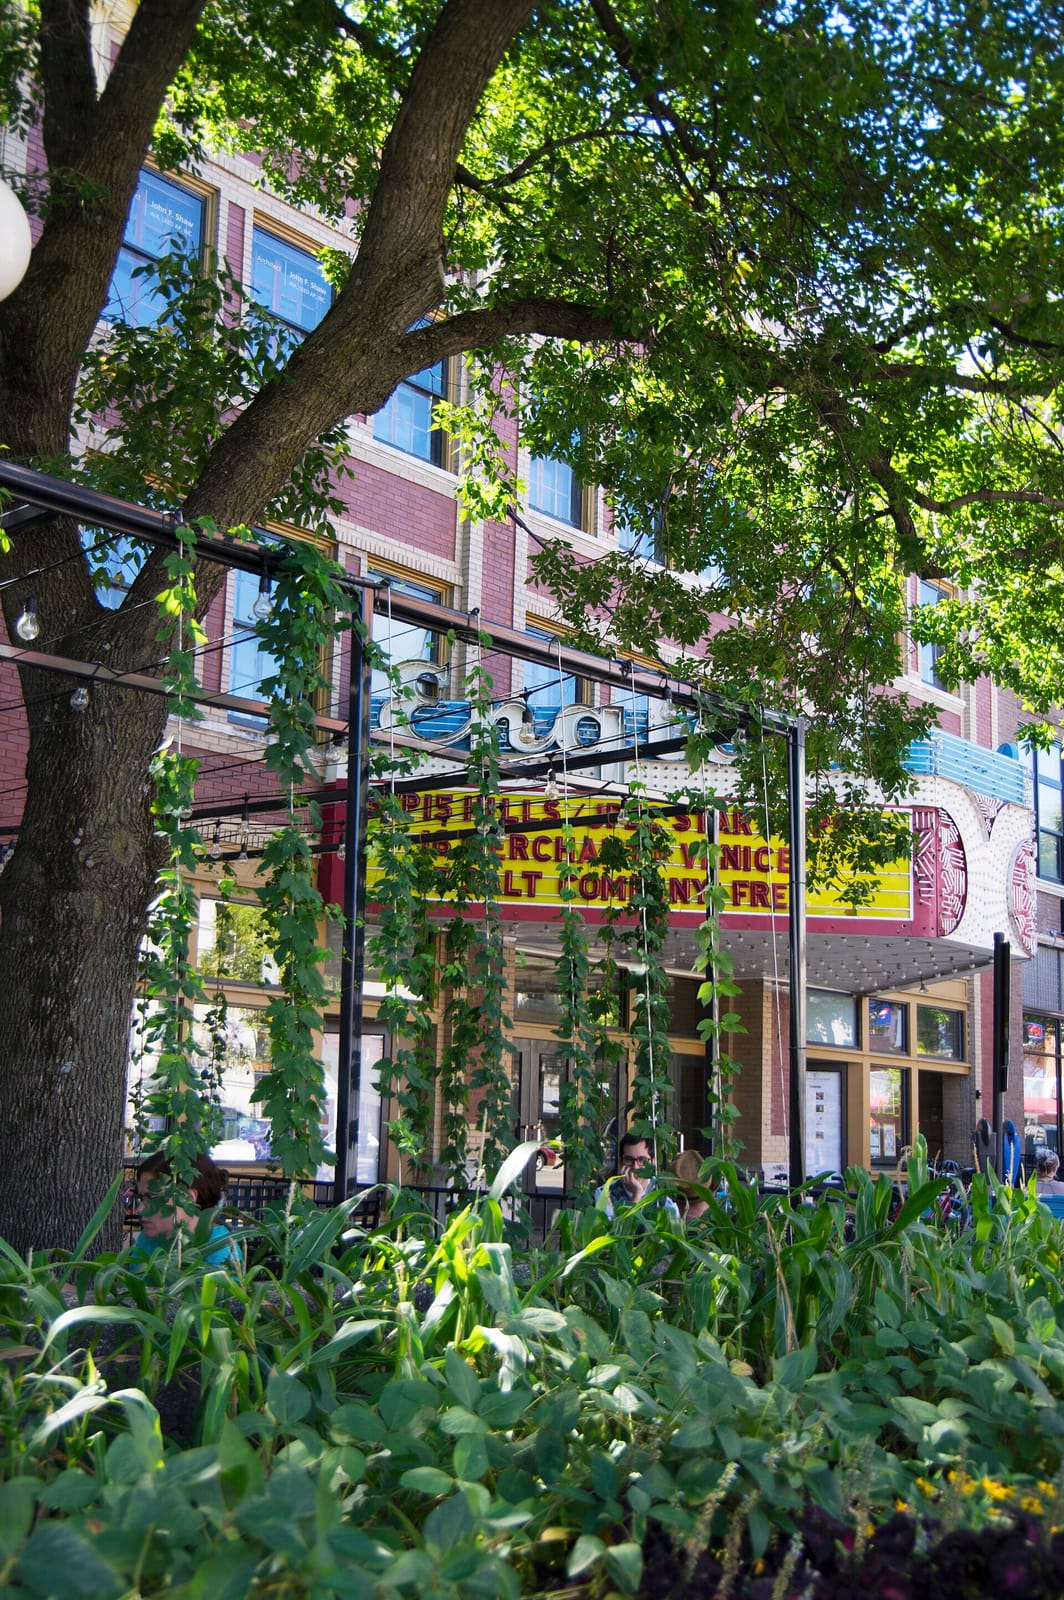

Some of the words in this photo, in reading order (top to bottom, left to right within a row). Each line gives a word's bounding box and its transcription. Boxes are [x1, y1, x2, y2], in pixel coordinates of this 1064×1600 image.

[151, 201, 167, 214] John
[175, 213, 194, 228] Shaw
[256, 255, 282, 273] Architect
[289, 271, 304, 283] John
[310, 281, 327, 295] Shaw
